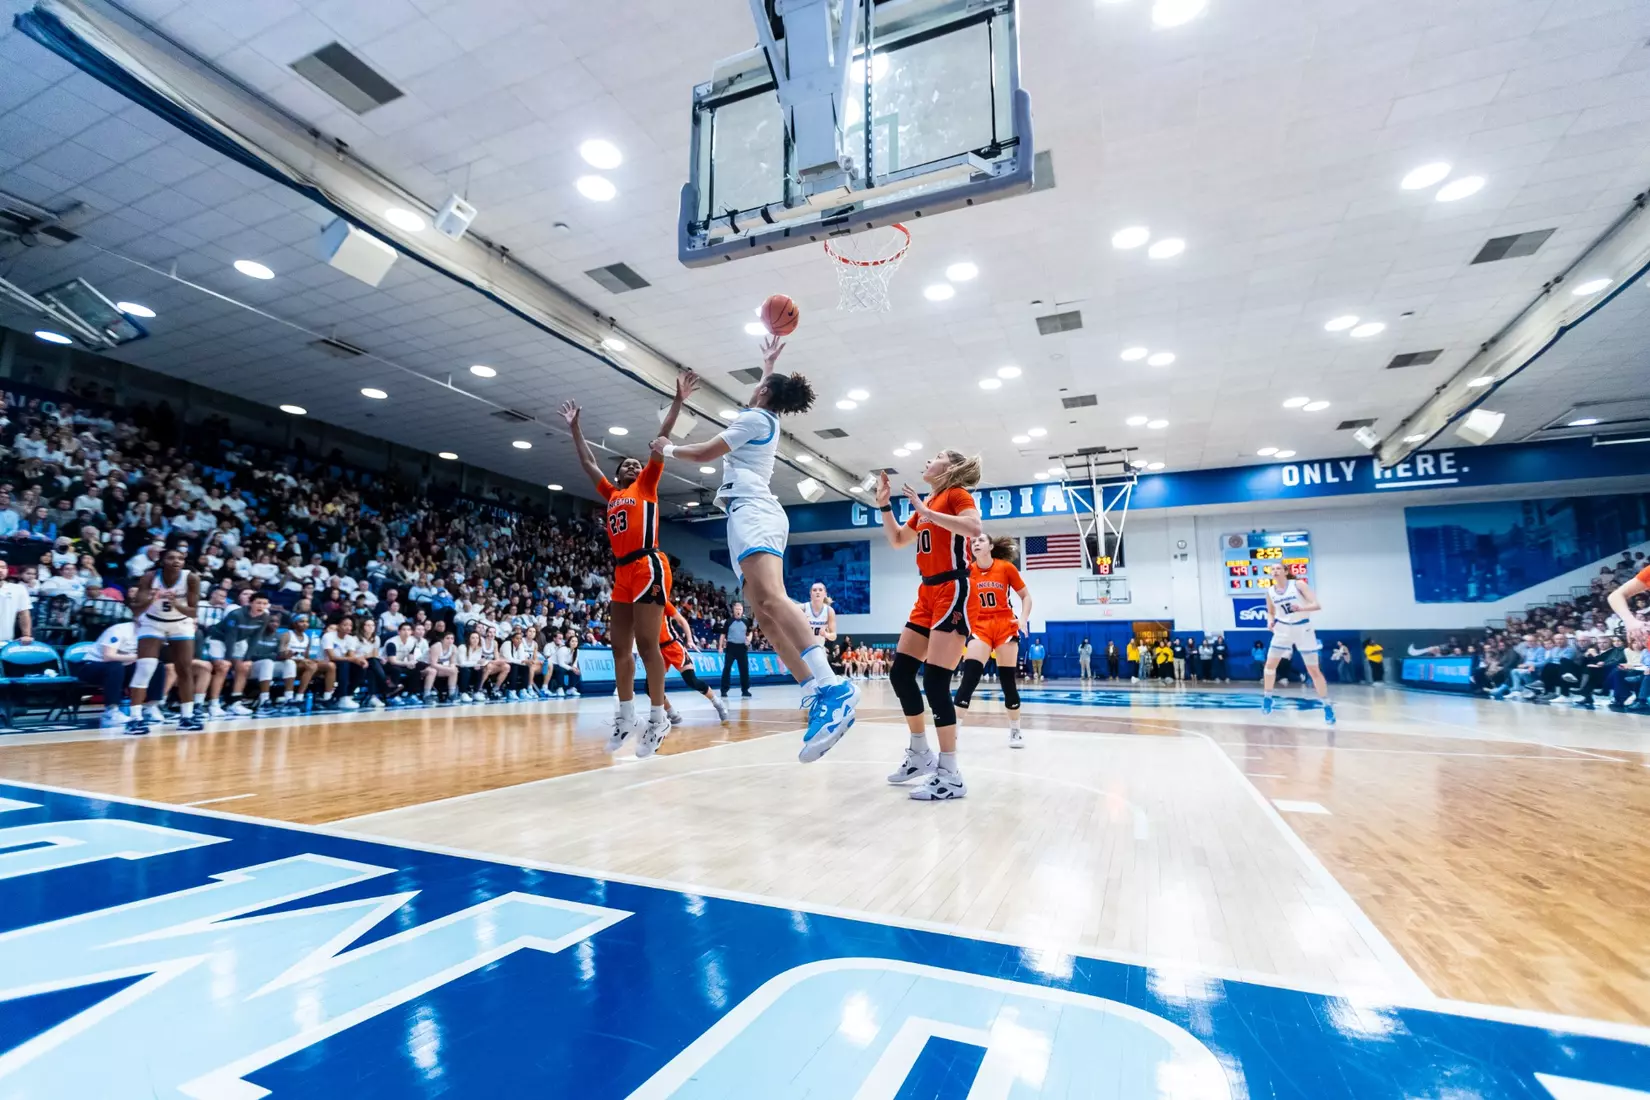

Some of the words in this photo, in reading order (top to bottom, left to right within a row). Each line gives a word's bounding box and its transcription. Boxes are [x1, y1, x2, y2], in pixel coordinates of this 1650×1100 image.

[1282, 460, 1356, 487] ONLY
[608, 509, 629, 536] 23
[1256, 547, 1283, 560] 2:55
[1233, 566, 1248, 576] 49
[1291, 564, 1308, 576] 66
[161, 601, 171, 612] 5
[979, 592, 997, 608] 10
[698, 656, 718, 673] FOR
